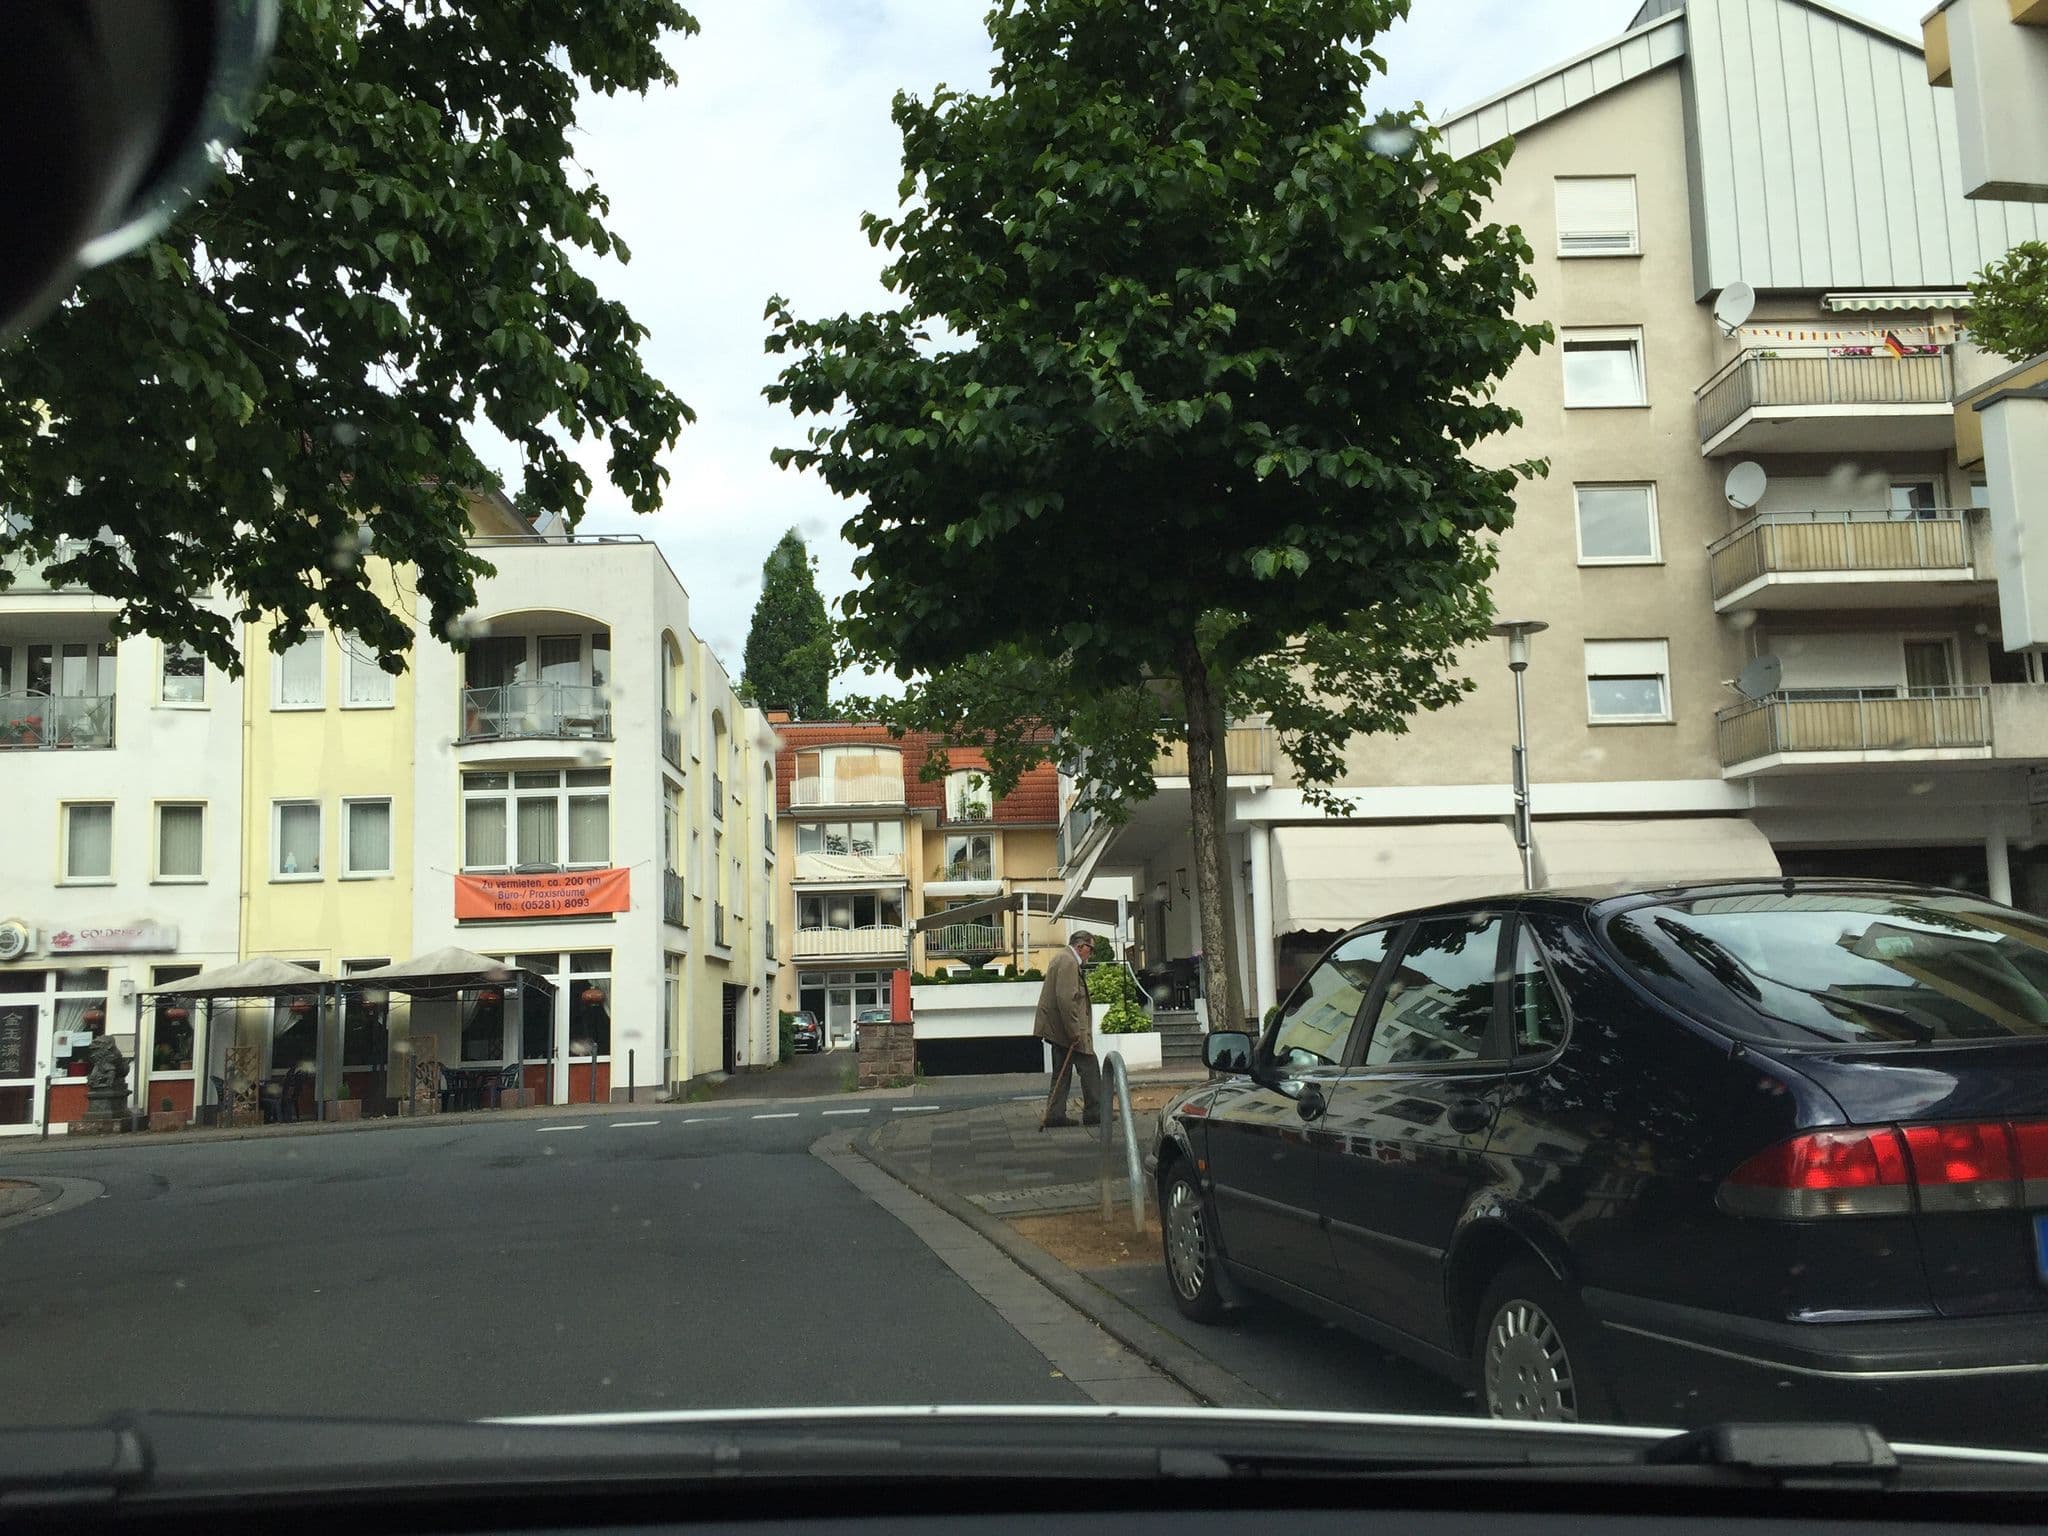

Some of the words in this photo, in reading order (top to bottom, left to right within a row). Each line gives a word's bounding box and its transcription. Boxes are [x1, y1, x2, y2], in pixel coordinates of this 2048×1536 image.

[481, 879, 493, 889] Zu
[495, 879, 545, 889] vermieten,
[547, 879, 562, 887] ca.
[564, 876, 584, 887] 200
[586, 876, 601, 887] qm
[529, 888, 586, 899] Praxisräume
[520, 899, 562, 912] (05281)
[564, 897, 590, 909] 8093
